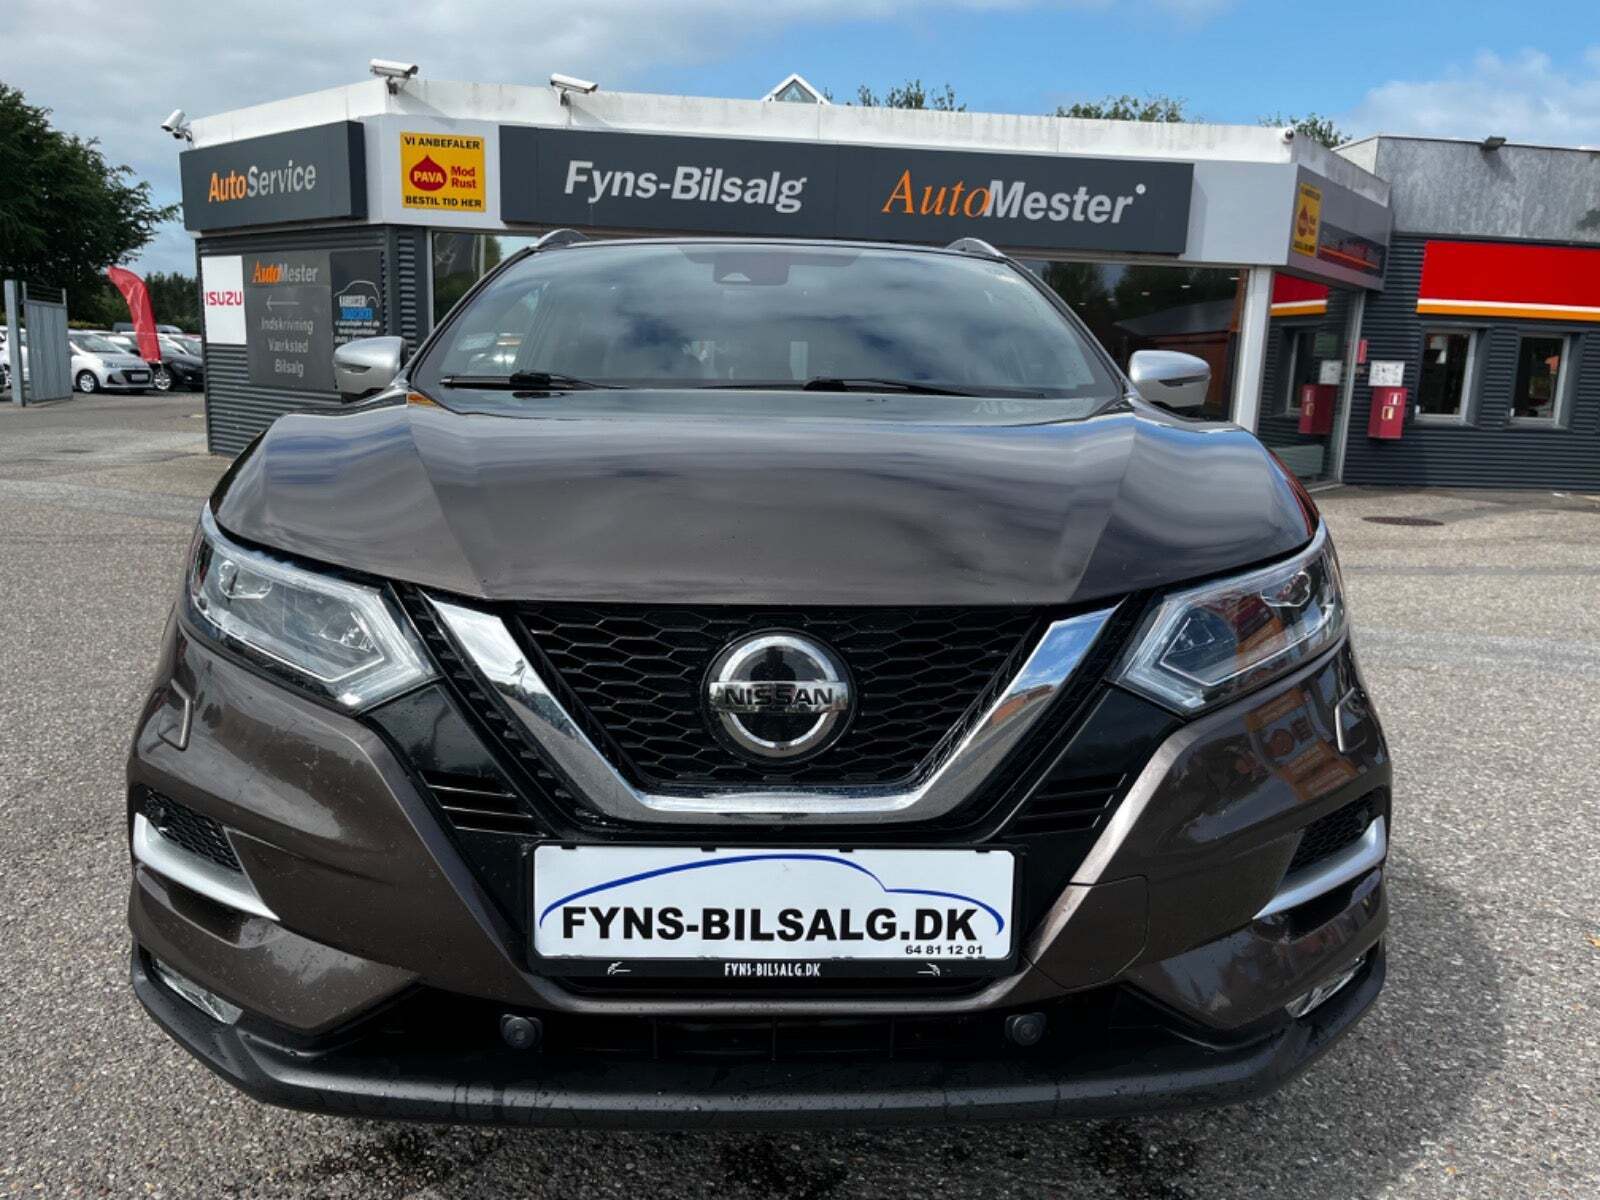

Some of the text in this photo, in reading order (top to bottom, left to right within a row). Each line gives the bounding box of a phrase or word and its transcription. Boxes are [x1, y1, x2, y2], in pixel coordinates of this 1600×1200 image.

[404, 136, 481, 150] VI ANBEFALER
[413, 170, 445, 184] PAVA
[451, 165, 476, 177] Mod
[208, 159, 317, 203] AutoService
[451, 177, 477, 189] Rust
[564, 160, 808, 214] Fyns-Bilsalg
[405, 195, 482, 208] BESTIL TID HER
[880, 168, 1134, 224] AutoMester
[251, 261, 319, 284] AutoMester
[205, 291, 244, 306] ISUZU
[261, 317, 314, 336] Indskrivning
[268, 339, 309, 353] Værksted
[274, 358, 304, 378] Bilsalg
[724, 687, 833, 706] NISSAN
[562, 906, 978, 942] FYNS-BILSALG.DK
[905, 945, 984, 955] 64 81 12 01
[724, 962, 822, 977] FYNS-BILSALG.DK
